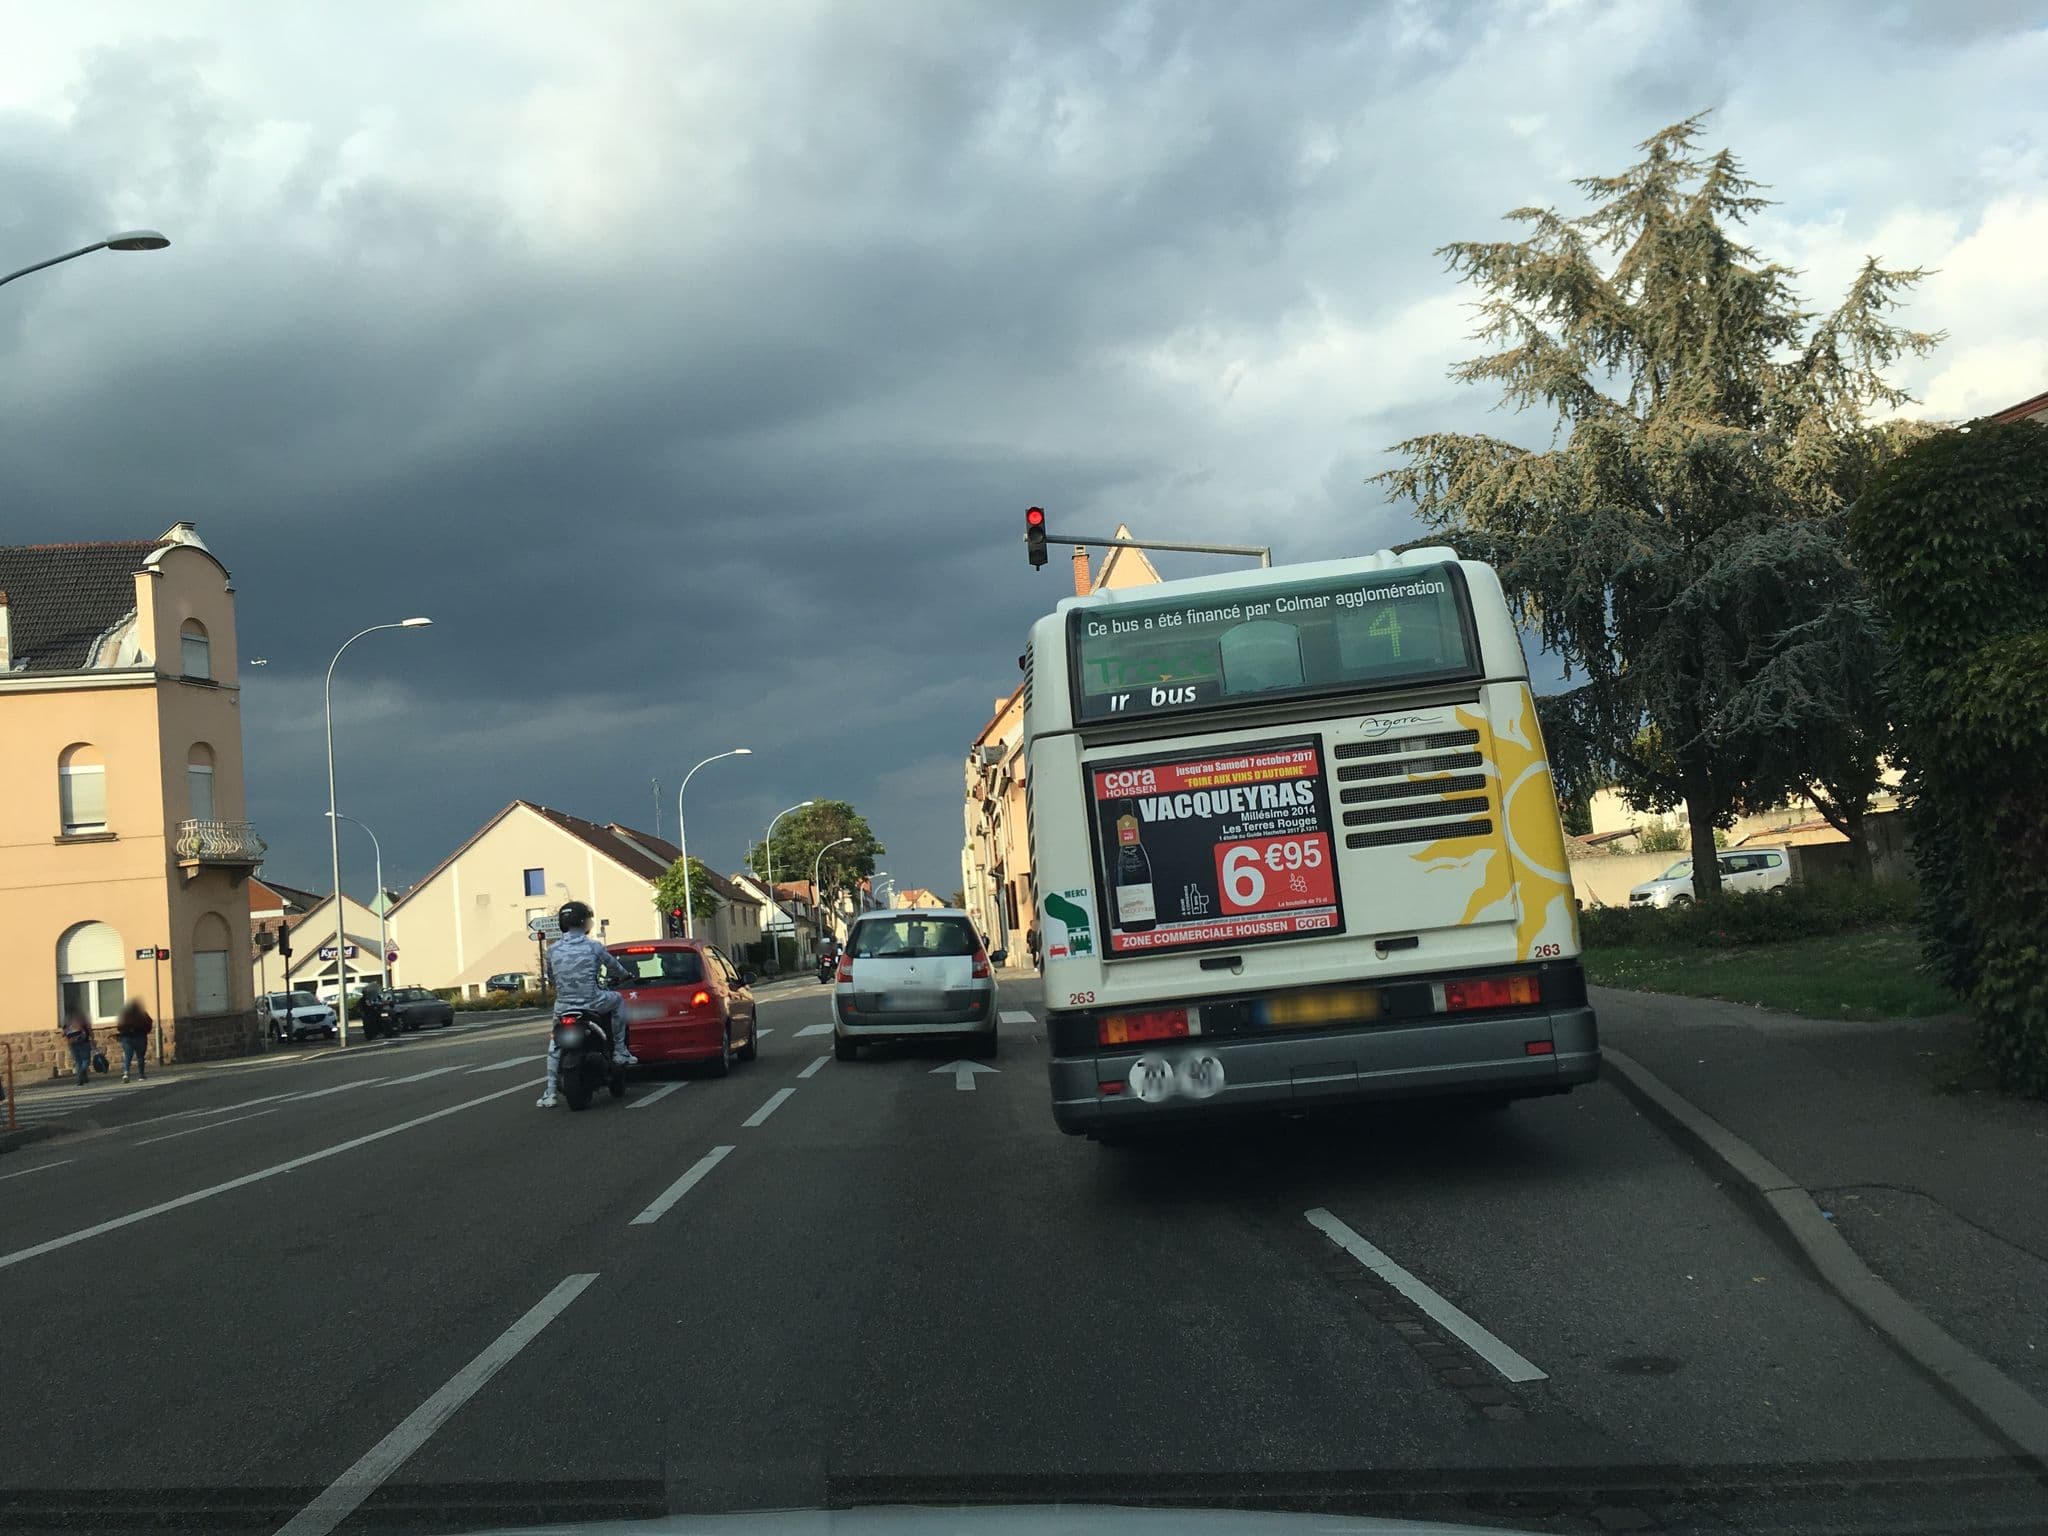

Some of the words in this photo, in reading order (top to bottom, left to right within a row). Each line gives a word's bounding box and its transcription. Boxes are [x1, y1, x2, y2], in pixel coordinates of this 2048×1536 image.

[1088, 622, 1108, 637] Ce
[1112, 619, 1139, 635] bus
[1144, 618, 1153, 630] a
[1158, 613, 1182, 628] été
[1186, 604, 1241, 625] financé
[1245, 603, 1271, 621] par
[1275, 596, 1331, 614] Colmar
[1335, 580, 1445, 609] agglomération
[1369, 604, 1402, 657] 4
[1151, 686, 1197, 707] bus
[1360, 716, 1443, 737] Agora
[1215, 758, 1249, 771] Samedi
[1250, 757, 1257, 767] 7
[1257, 754, 1291, 766] octobre
[1292, 751, 1313, 762] 2017
[1105, 768, 1155, 789] cora
[1213, 773, 1231, 784] AUX
[1231, 771, 1253, 781] VINS
[1106, 785, 1157, 798] HOUSSEN
[1138, 780, 1314, 823] VACQUEYRAS
[1241, 808, 1289, 822] Millésime
[1291, 804, 1316, 816] 2014
[1222, 824, 1242, 835] Les
[1242, 819, 1275, 832] Terres
[1278, 816, 1317, 829] Rouges
[1064, 888, 1088, 898] MERCI
[1122, 934, 1152, 947] ZONE
[1154, 927, 1233, 944] COMMERCIALE
[1236, 921, 1288, 935] HOUSSEN
[1298, 916, 1328, 930] cora
[1534, 943, 1560, 958] 263
[1070, 991, 1095, 1005] 263
